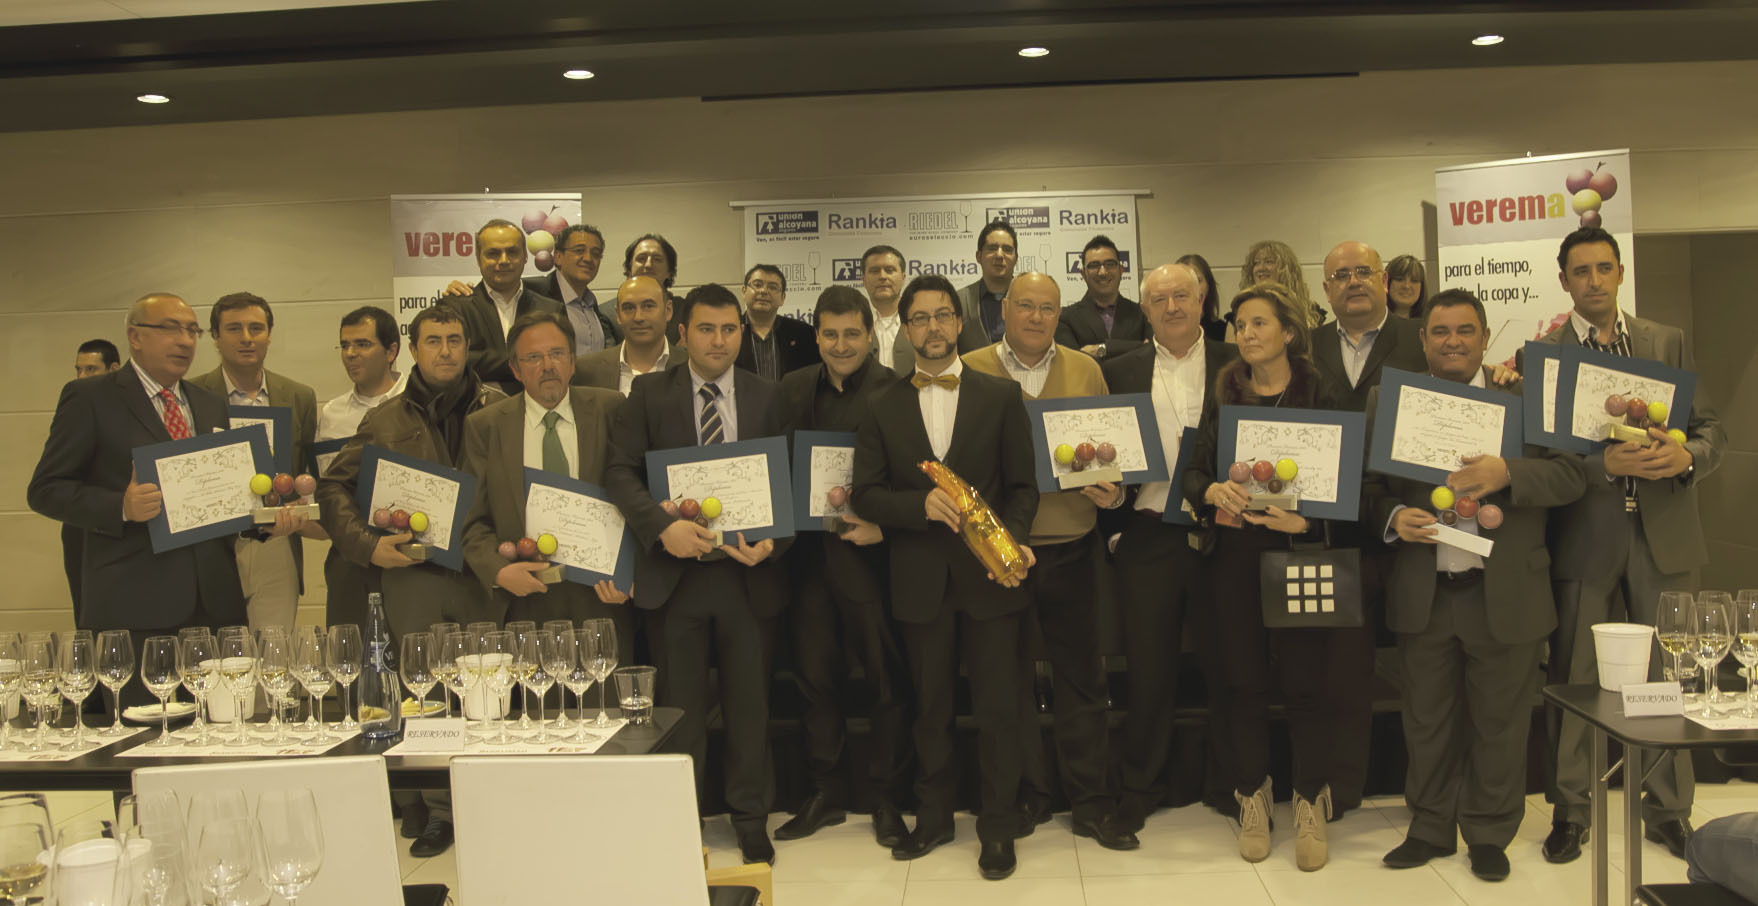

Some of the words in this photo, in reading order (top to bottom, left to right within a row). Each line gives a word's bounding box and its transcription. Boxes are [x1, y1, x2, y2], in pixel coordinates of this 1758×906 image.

[1059, 208, 1129, 226] Rankia
[1449, 193, 1566, 226] verema
[778, 220, 817, 230] alcoyana
[828, 212, 897, 230] Rankia
[908, 211, 959, 231] RIEDEL
[1008, 215, 1048, 225] alcoyana
[405, 231, 477, 258] vere
[908, 258, 979, 277] Rankia
[1444, 265, 1472, 283] para
[1474, 256, 1485, 276] el
[1487, 258, 1533, 278] tiempo,
[1491, 290, 1520, 305] copa
[1521, 286, 1540, 304] y...
[399, 296, 427, 314] para
[1625, 694, 1678, 704] RESERVADO
[407, 730, 460, 738] RESERVADO
